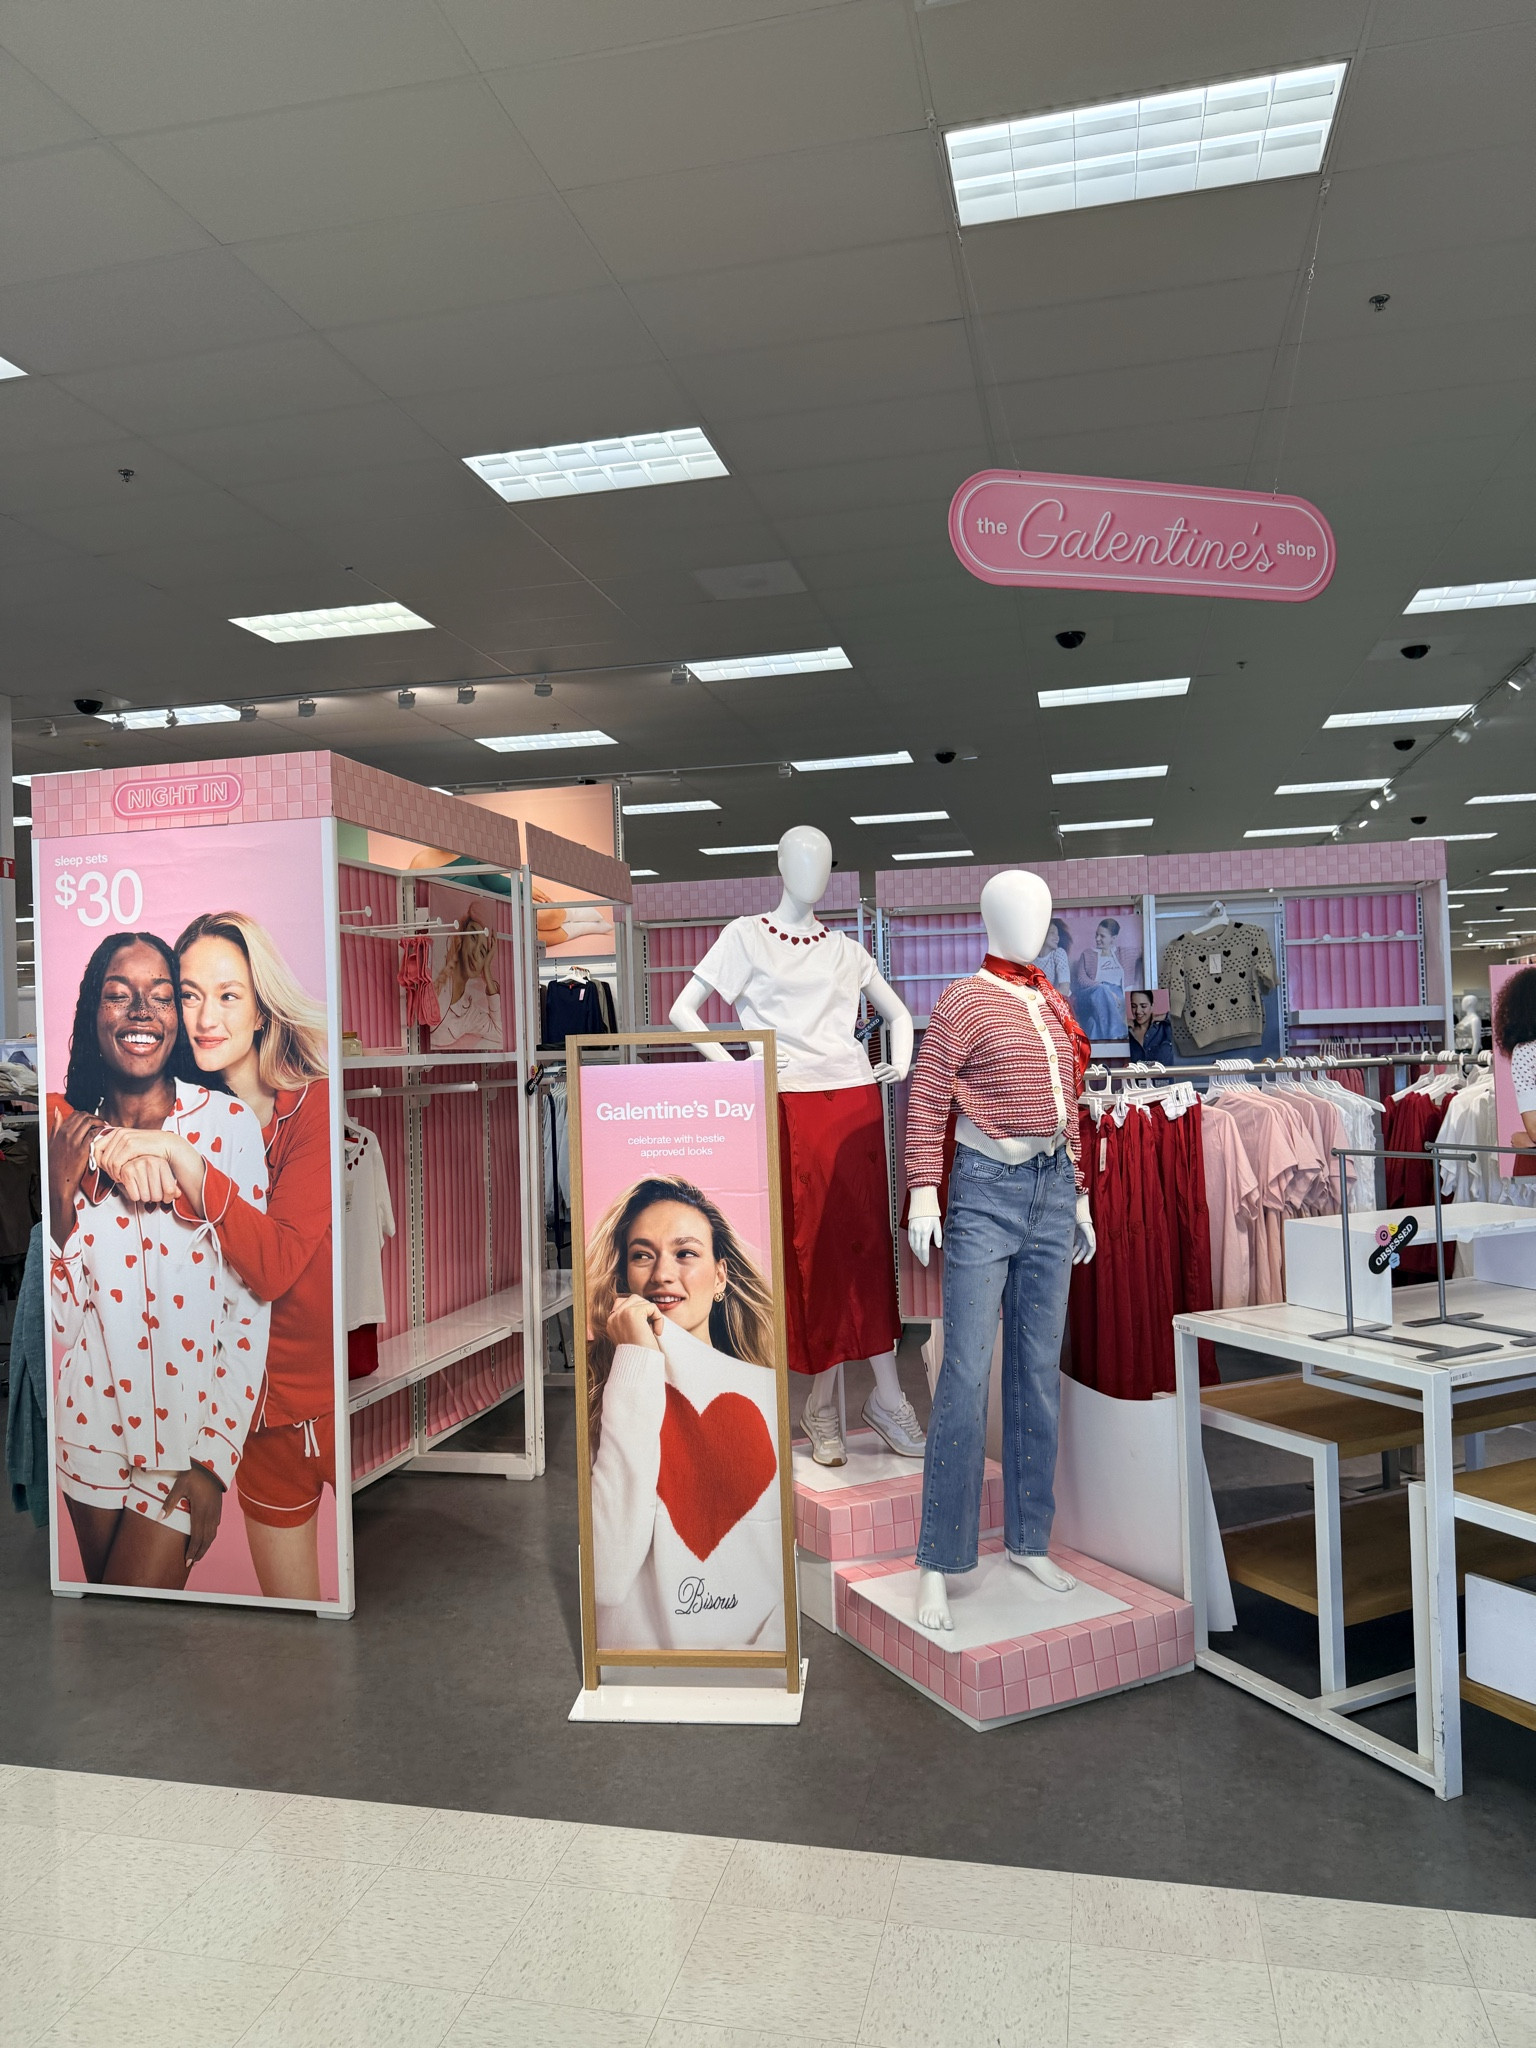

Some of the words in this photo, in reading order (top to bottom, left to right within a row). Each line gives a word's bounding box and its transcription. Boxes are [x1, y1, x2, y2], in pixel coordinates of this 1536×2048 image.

[976, 516, 1008, 536] the
[1017, 498, 1275, 574] Galentine's
[1276, 540, 1317, 561] shop
[128, 785, 198, 809] NIGHT
[203, 782, 228, 802] IN
[55, 854, 82, 868] sleep
[85, 852, 108, 866] sets
[55, 869, 143, 927] $30
[596, 1100, 708, 1121] Galentine's
[714, 1098, 756, 1121] Day
[627, 1134, 672, 1145] celebrate
[673, 1133, 694, 1144] with
[695, 1132, 726, 1144] bestie
[640, 1147, 685, 1158] approved
[687, 1146, 713, 1156] looks
[1375, 1223, 1414, 1266] OBSESSED
[674, 1575, 739, 1615] Bisous
